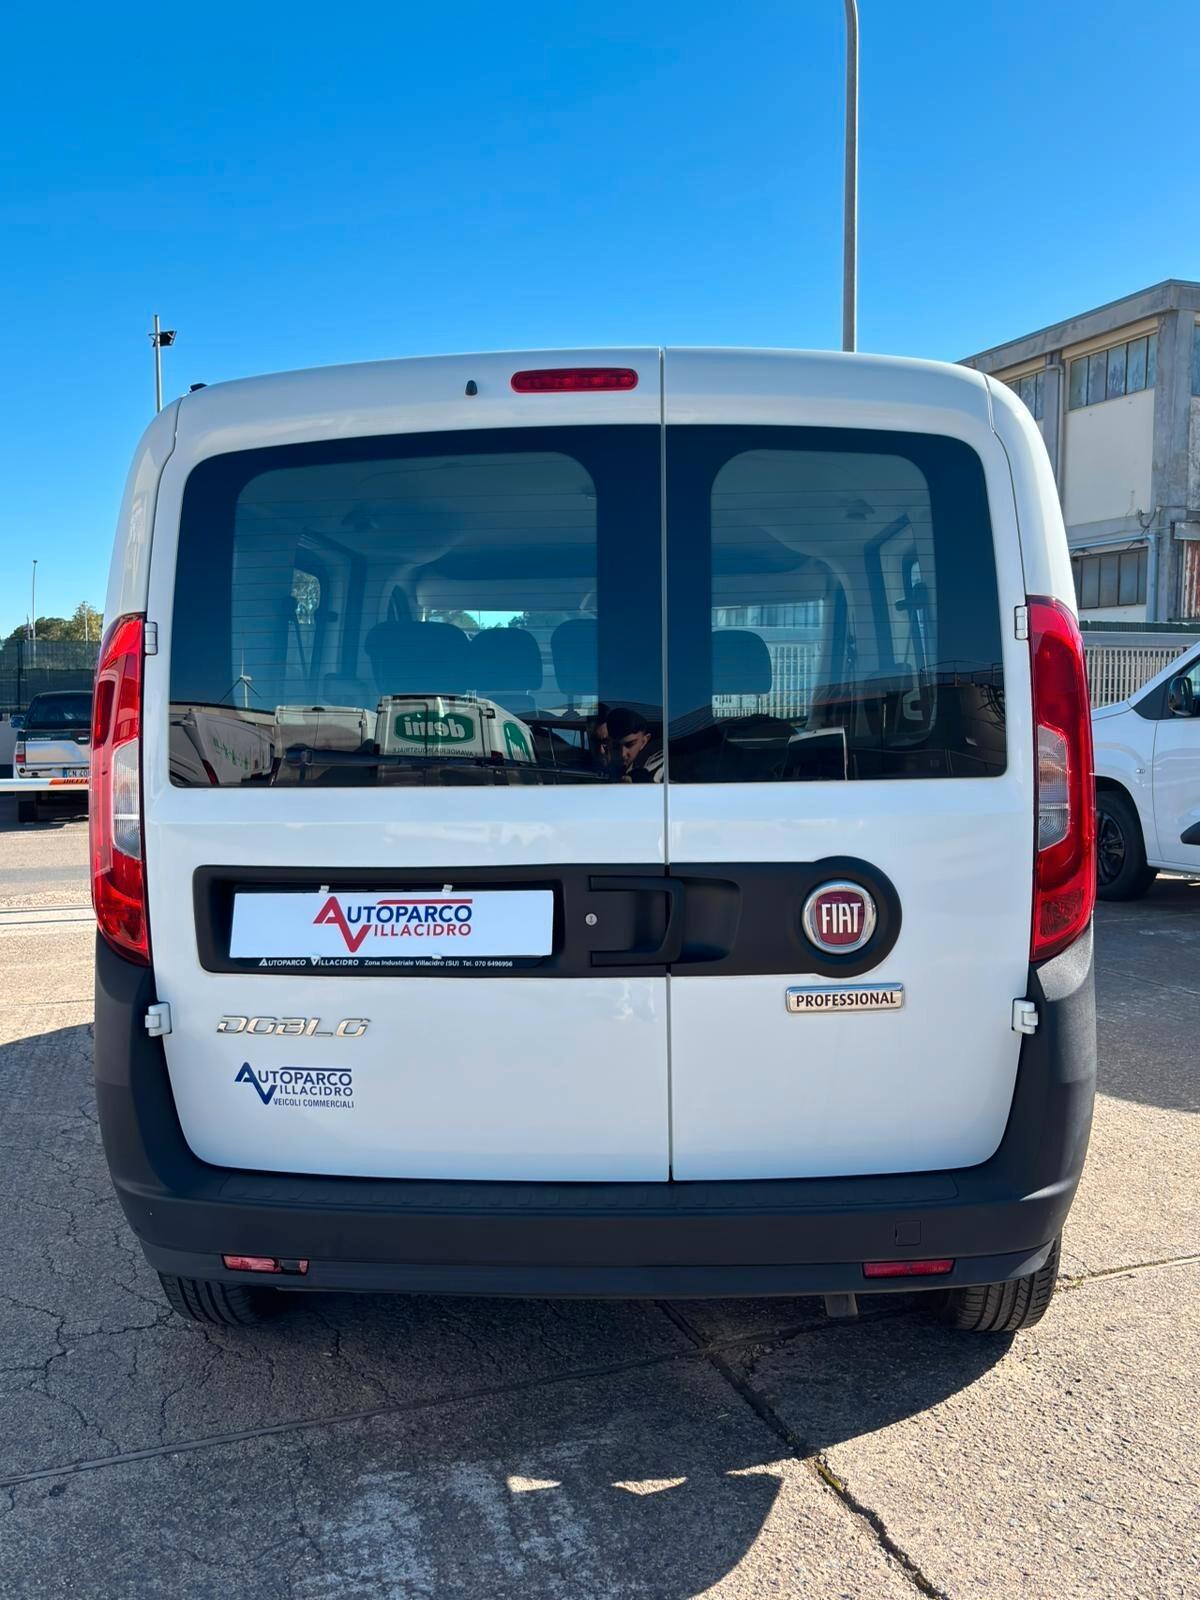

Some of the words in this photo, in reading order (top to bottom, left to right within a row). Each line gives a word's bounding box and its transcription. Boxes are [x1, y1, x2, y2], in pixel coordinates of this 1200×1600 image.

[313, 896, 473, 924] AUTOPARCO
[821, 902, 862, 934] FIAT
[340, 923, 472, 953] VILLACIDRO
[258, 958, 306, 967] AUTOPARCO
[311, 958, 359, 967] VILLACIDRO
[415, 959, 444, 967] Villacidro
[796, 992, 897, 1008] PROFESSIONAL
[234, 1061, 353, 1087] AUTOPARCO
[252, 1084, 353, 1105] VILLACIDRO
[273, 1097, 301, 1107] VEICOLI
[303, 1098, 355, 1109] COMMERCIALI
